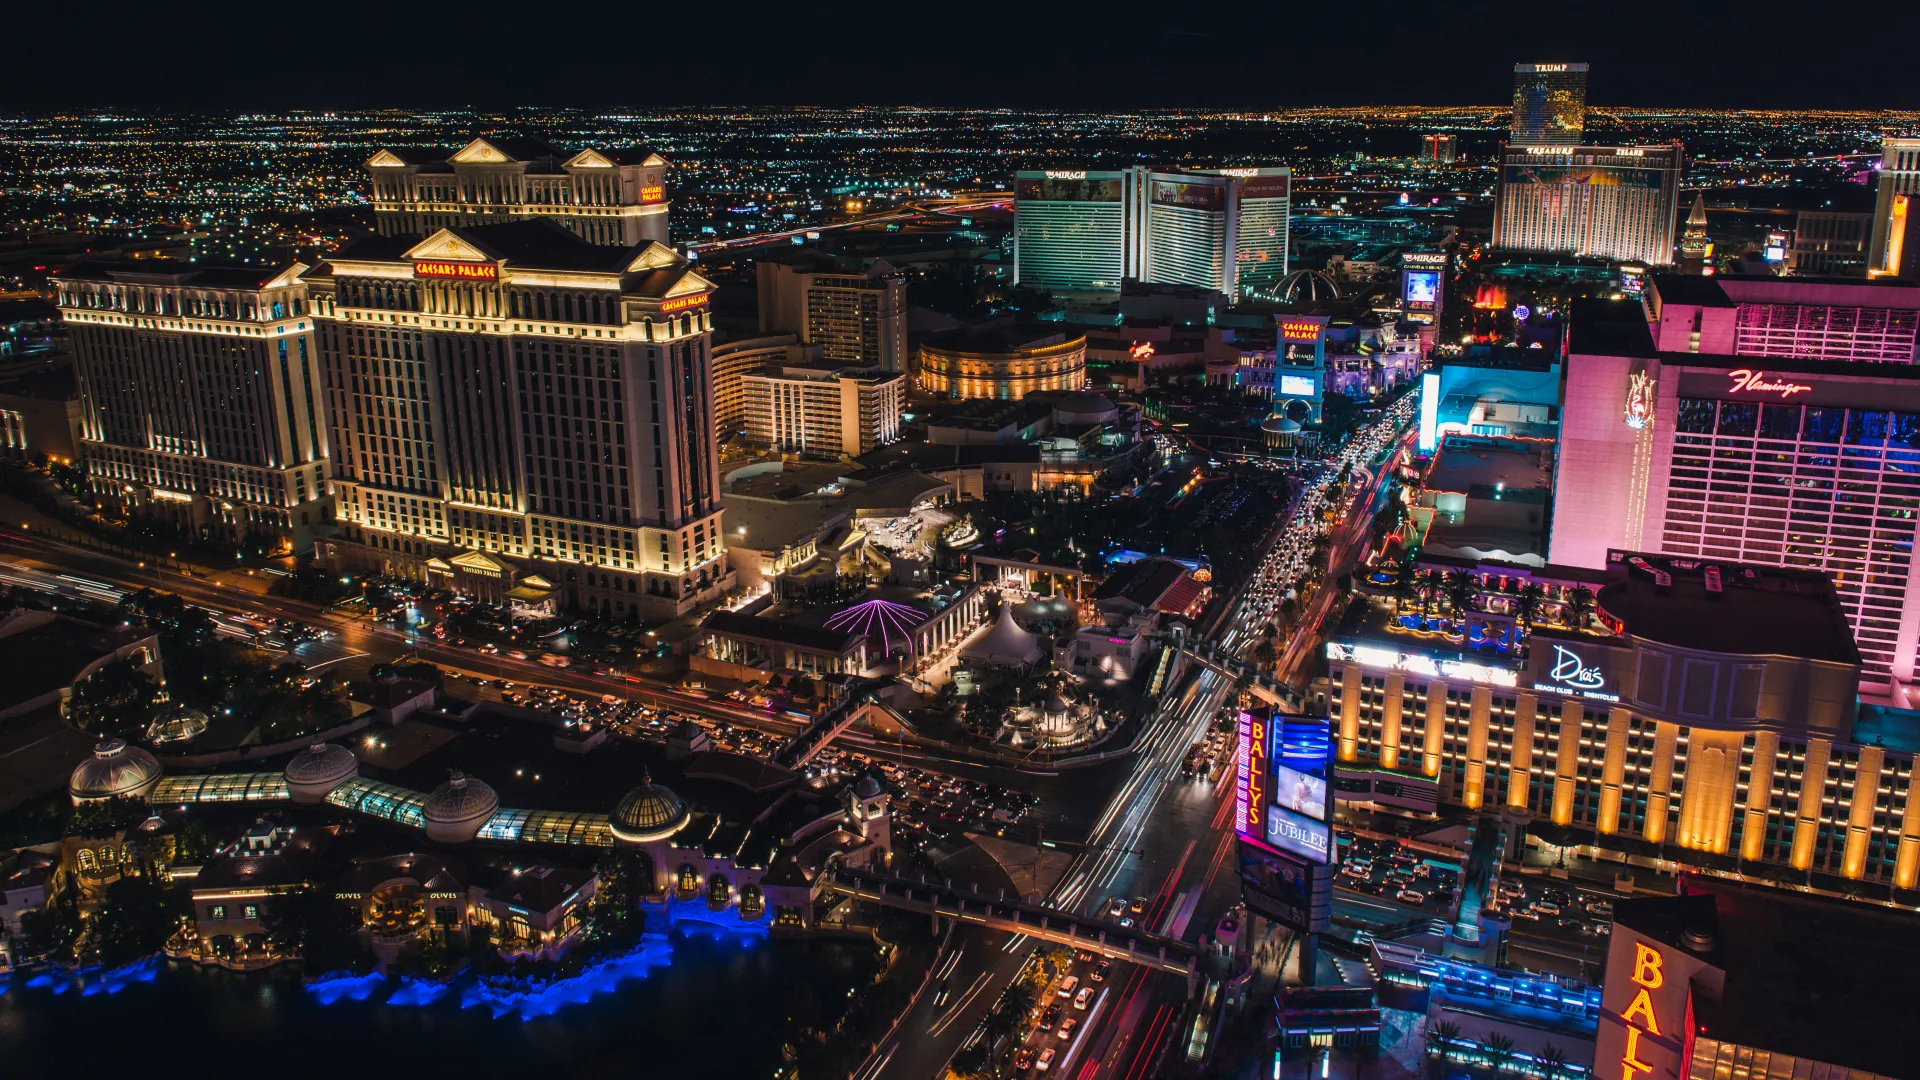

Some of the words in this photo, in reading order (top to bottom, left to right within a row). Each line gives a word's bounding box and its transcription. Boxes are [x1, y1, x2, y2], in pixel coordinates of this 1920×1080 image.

[1534, 64, 1568, 72] TRUMP
[1526, 147, 1574, 155] TREASURE
[1616, 148, 1644, 157] ISLAND
[1052, 171, 1087, 179] MIRAGE
[1227, 168, 1259, 177] MIRAGE
[641, 186, 662, 195] CAESARS
[642, 193, 662, 201] PALACE
[1411, 255, 1446, 263] MIRAGE
[416, 263, 456, 276] CAESARS
[458, 265, 495, 278] PALACE
[662, 299, 687, 312] CAESARS
[687, 294, 708, 306] PALACE
[1282, 323, 1319, 332] CAESARS
[1284, 330, 1317, 339] PALACE
[1728, 369, 1812, 398] Flamingo
[1534, 683, 1556, 692] BEACH
[1556, 687, 1573, 695] CLUB
[1583, 691, 1620, 702] NIGHTCLUB
